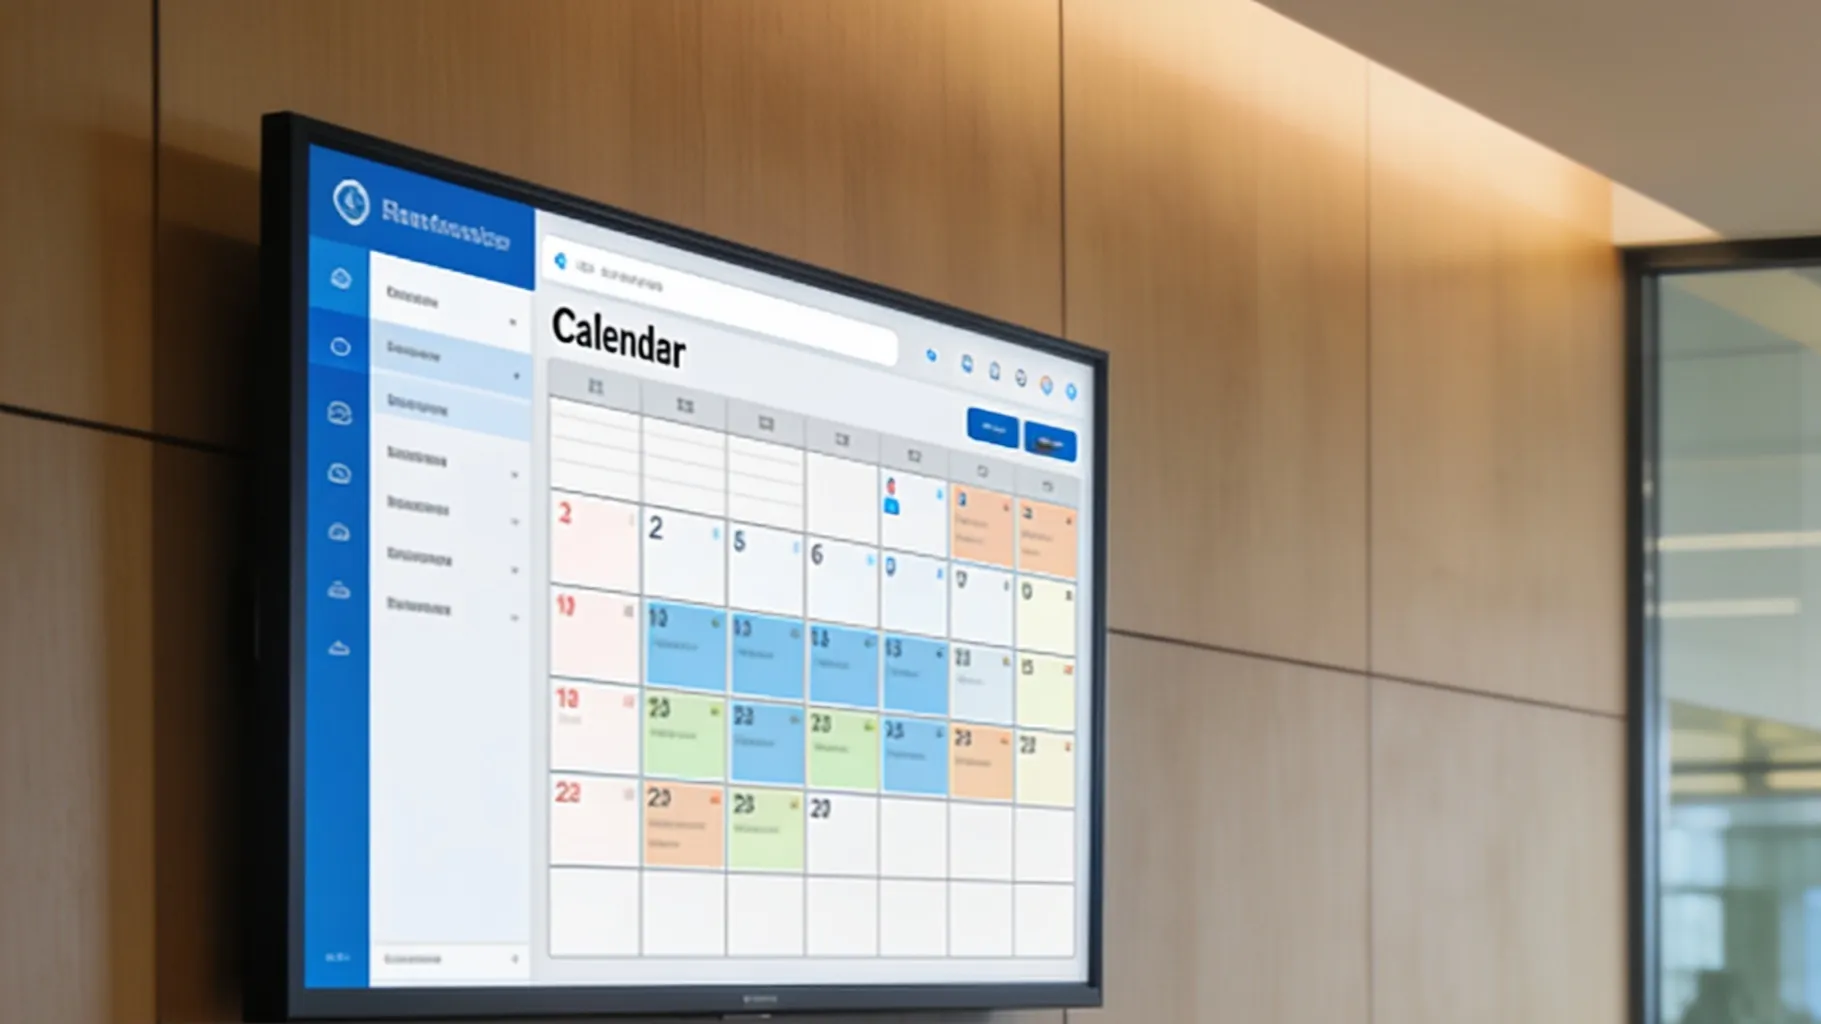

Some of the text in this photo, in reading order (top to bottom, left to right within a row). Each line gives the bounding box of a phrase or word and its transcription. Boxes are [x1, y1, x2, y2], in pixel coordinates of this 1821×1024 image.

[552, 307, 687, 369] Calendar
[649, 515, 663, 540] 2
[811, 543, 824, 565] 6
